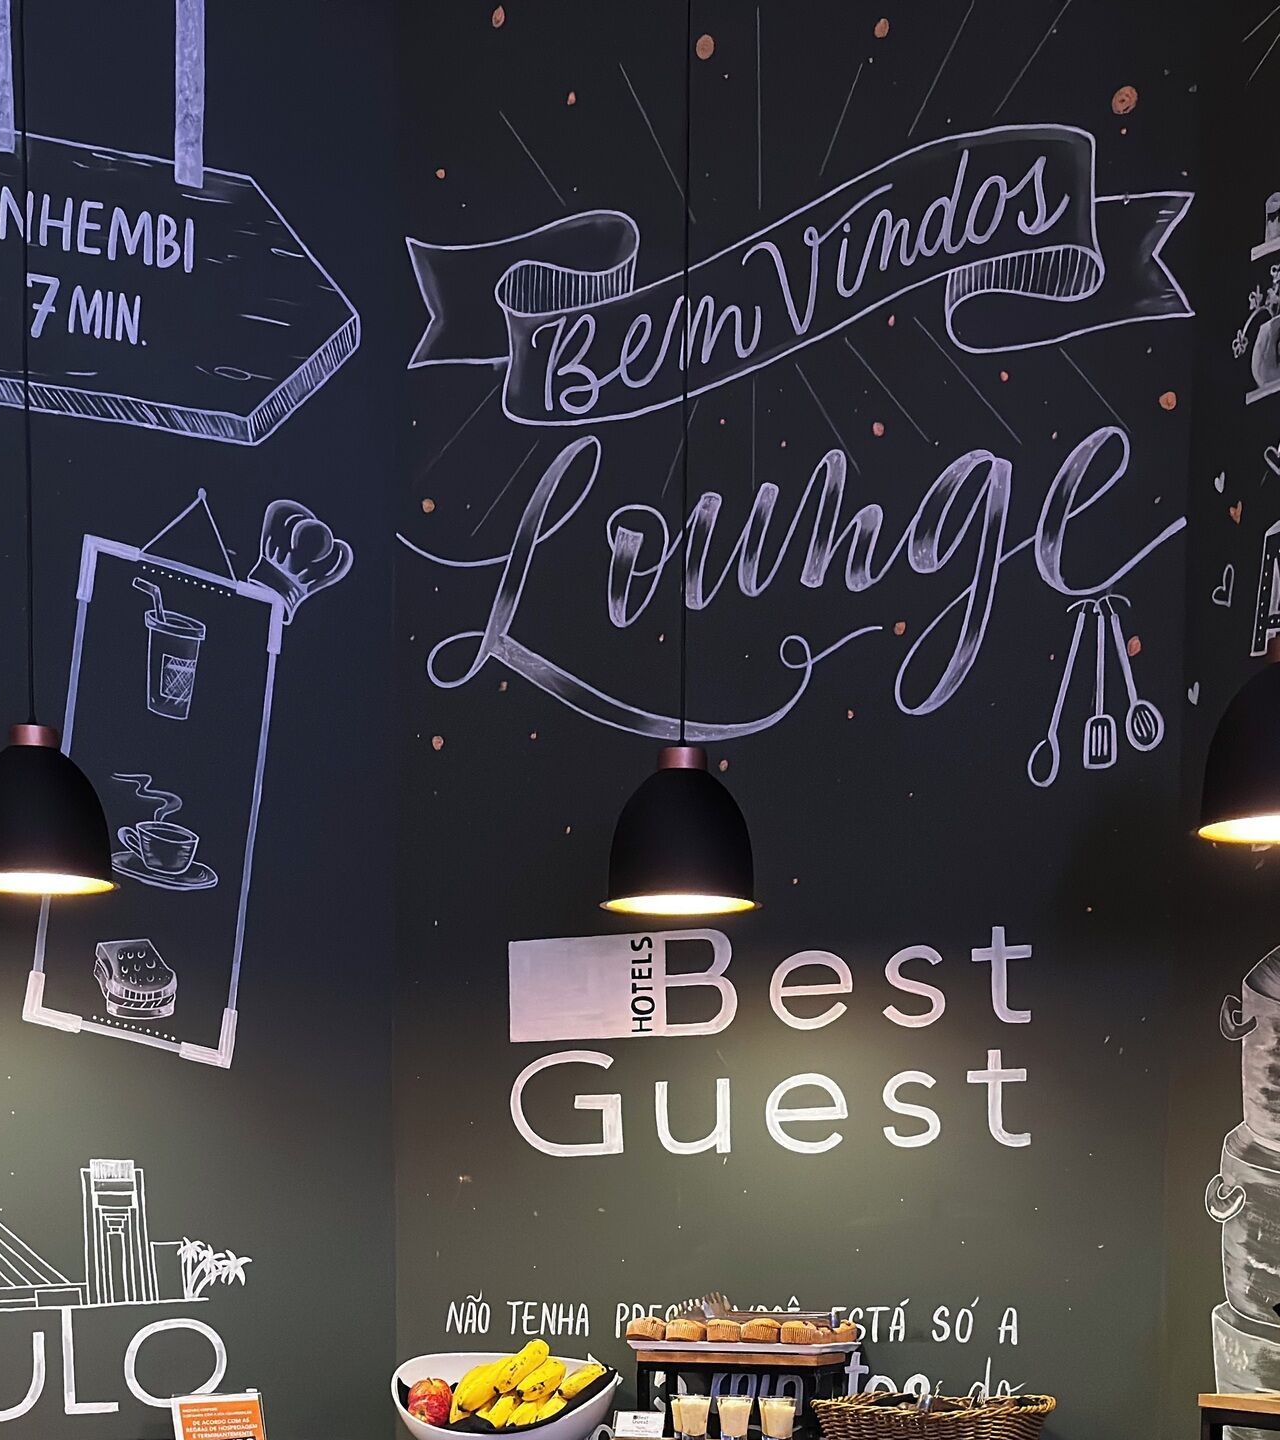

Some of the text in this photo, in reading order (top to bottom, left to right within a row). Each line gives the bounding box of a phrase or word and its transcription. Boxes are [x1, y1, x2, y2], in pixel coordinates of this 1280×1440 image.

[25, 273, 147, 347] 7 MIN.
[531, 149, 1071, 414] Bem Vindos
[397, 425, 1187, 742] Lounge
[630, 935, 655, 1034] HOTELS
[661, 926, 1032, 1036] Best
[509, 1049, 1032, 1157] Guest
[445, 1289, 491, 1335] NÃO
[506, 1300, 590, 1337] TENHA
[931, 1296, 980, 1343] SÓ
[998, 1306, 1018, 1346] A
